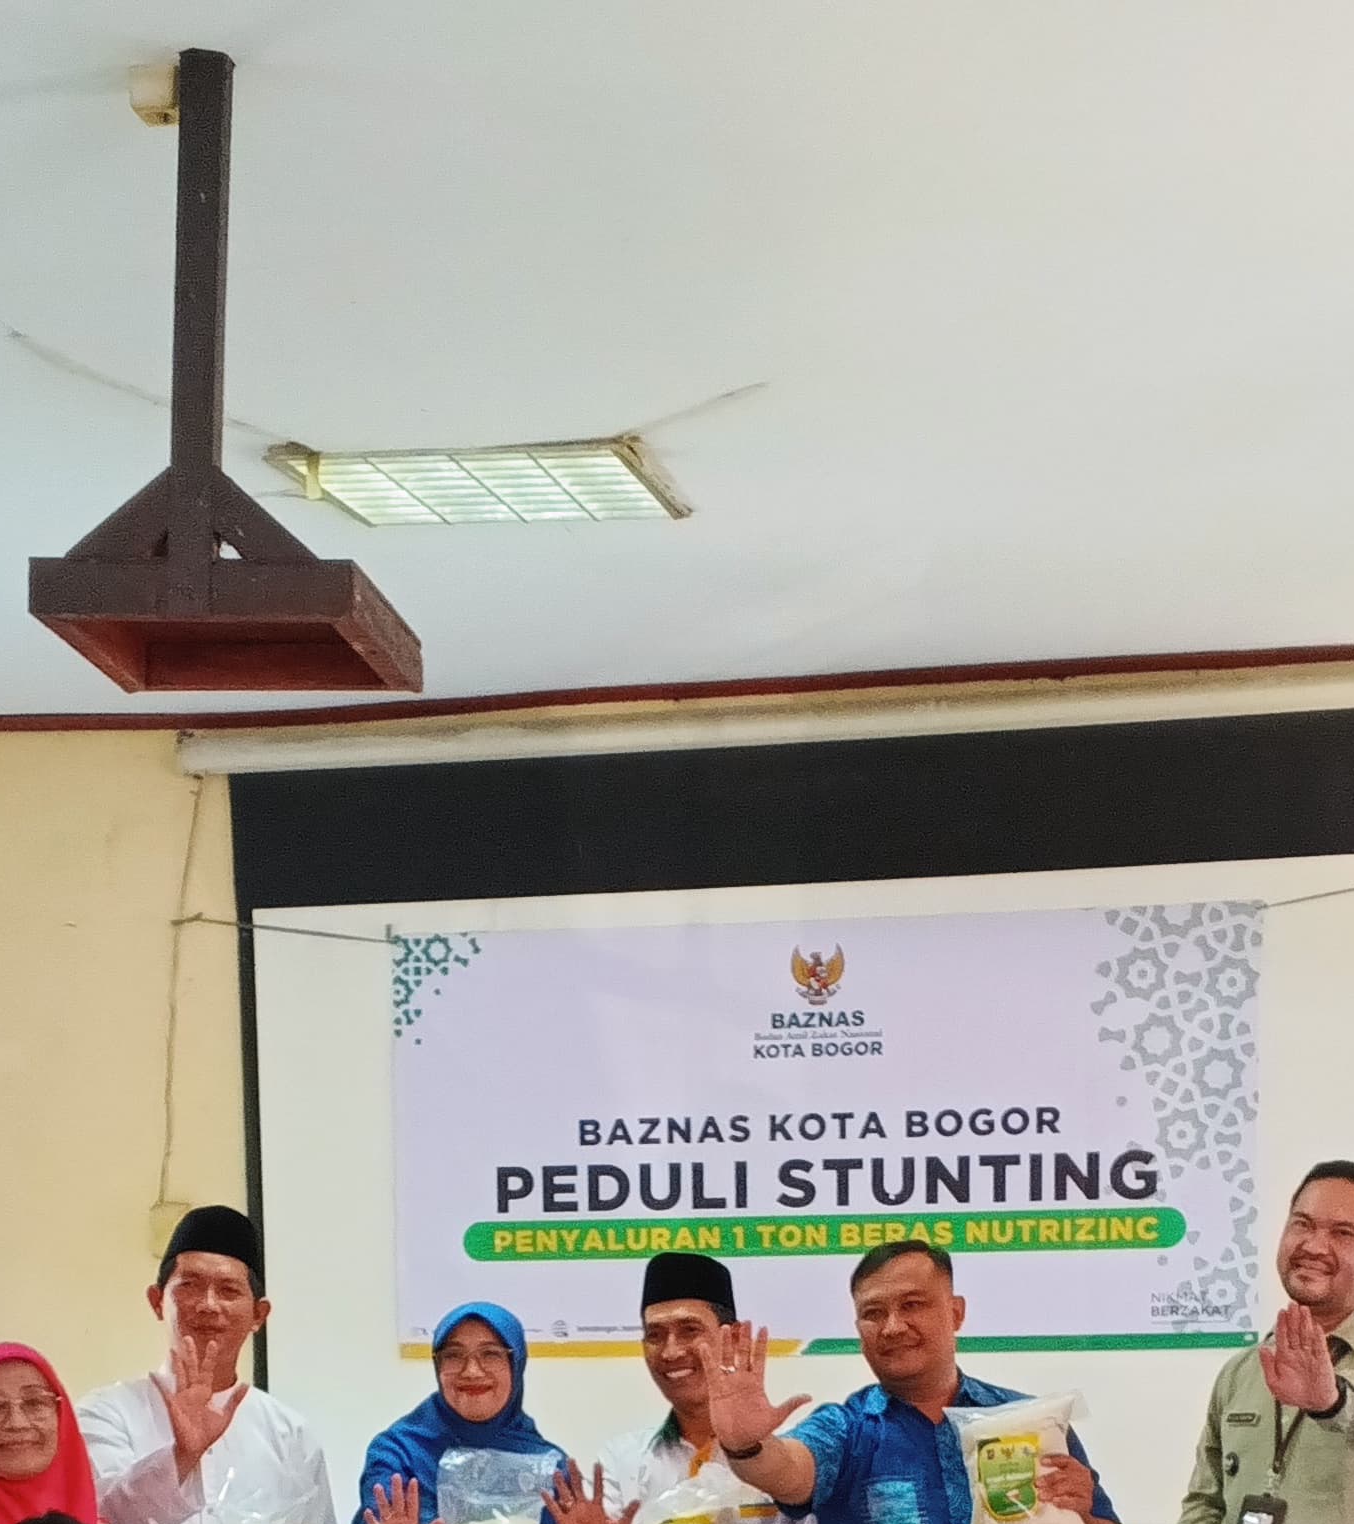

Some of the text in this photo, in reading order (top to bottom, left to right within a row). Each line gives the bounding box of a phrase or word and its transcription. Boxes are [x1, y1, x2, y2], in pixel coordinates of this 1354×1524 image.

[771, 1010, 865, 1029] BAZNAS
[753, 1041, 884, 1059] KOTA BOGOR
[579, 1106, 1061, 1146] BAZNAS KOTA BOGOR
[497, 1150, 1159, 1213] PEDULI STUNTING
[494, 1217, 1160, 1253] PENYALURAN 1 TON BERAS NUTRIZINC
[1151, 1305, 1231, 1317] BERZAKAT
